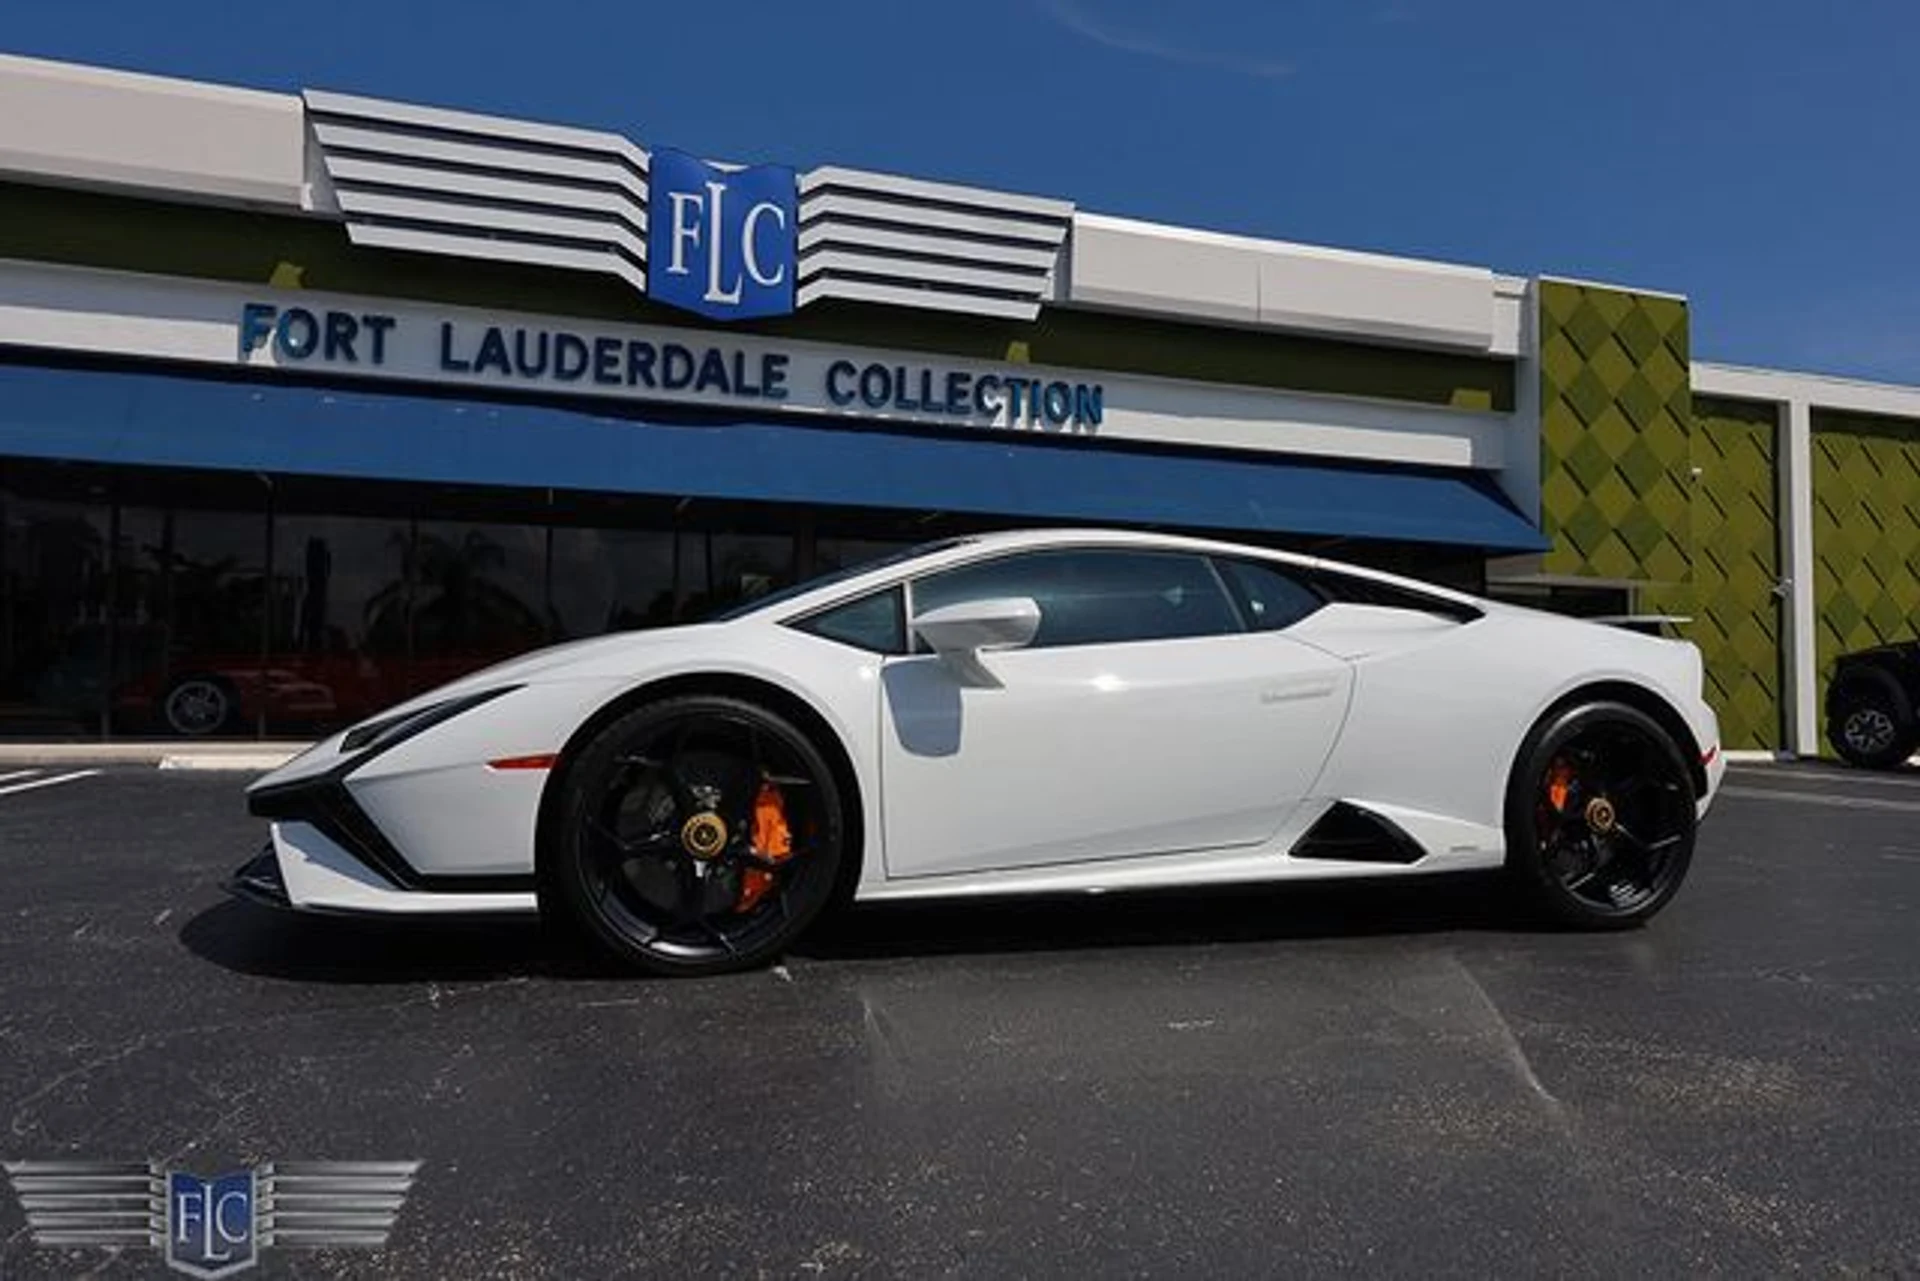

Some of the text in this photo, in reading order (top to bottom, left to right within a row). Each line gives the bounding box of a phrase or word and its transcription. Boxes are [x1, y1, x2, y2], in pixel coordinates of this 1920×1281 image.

[668, 181, 785, 304] FLC
[240, 303, 1103, 425] FORT LAUDERDALE COLLECTION
